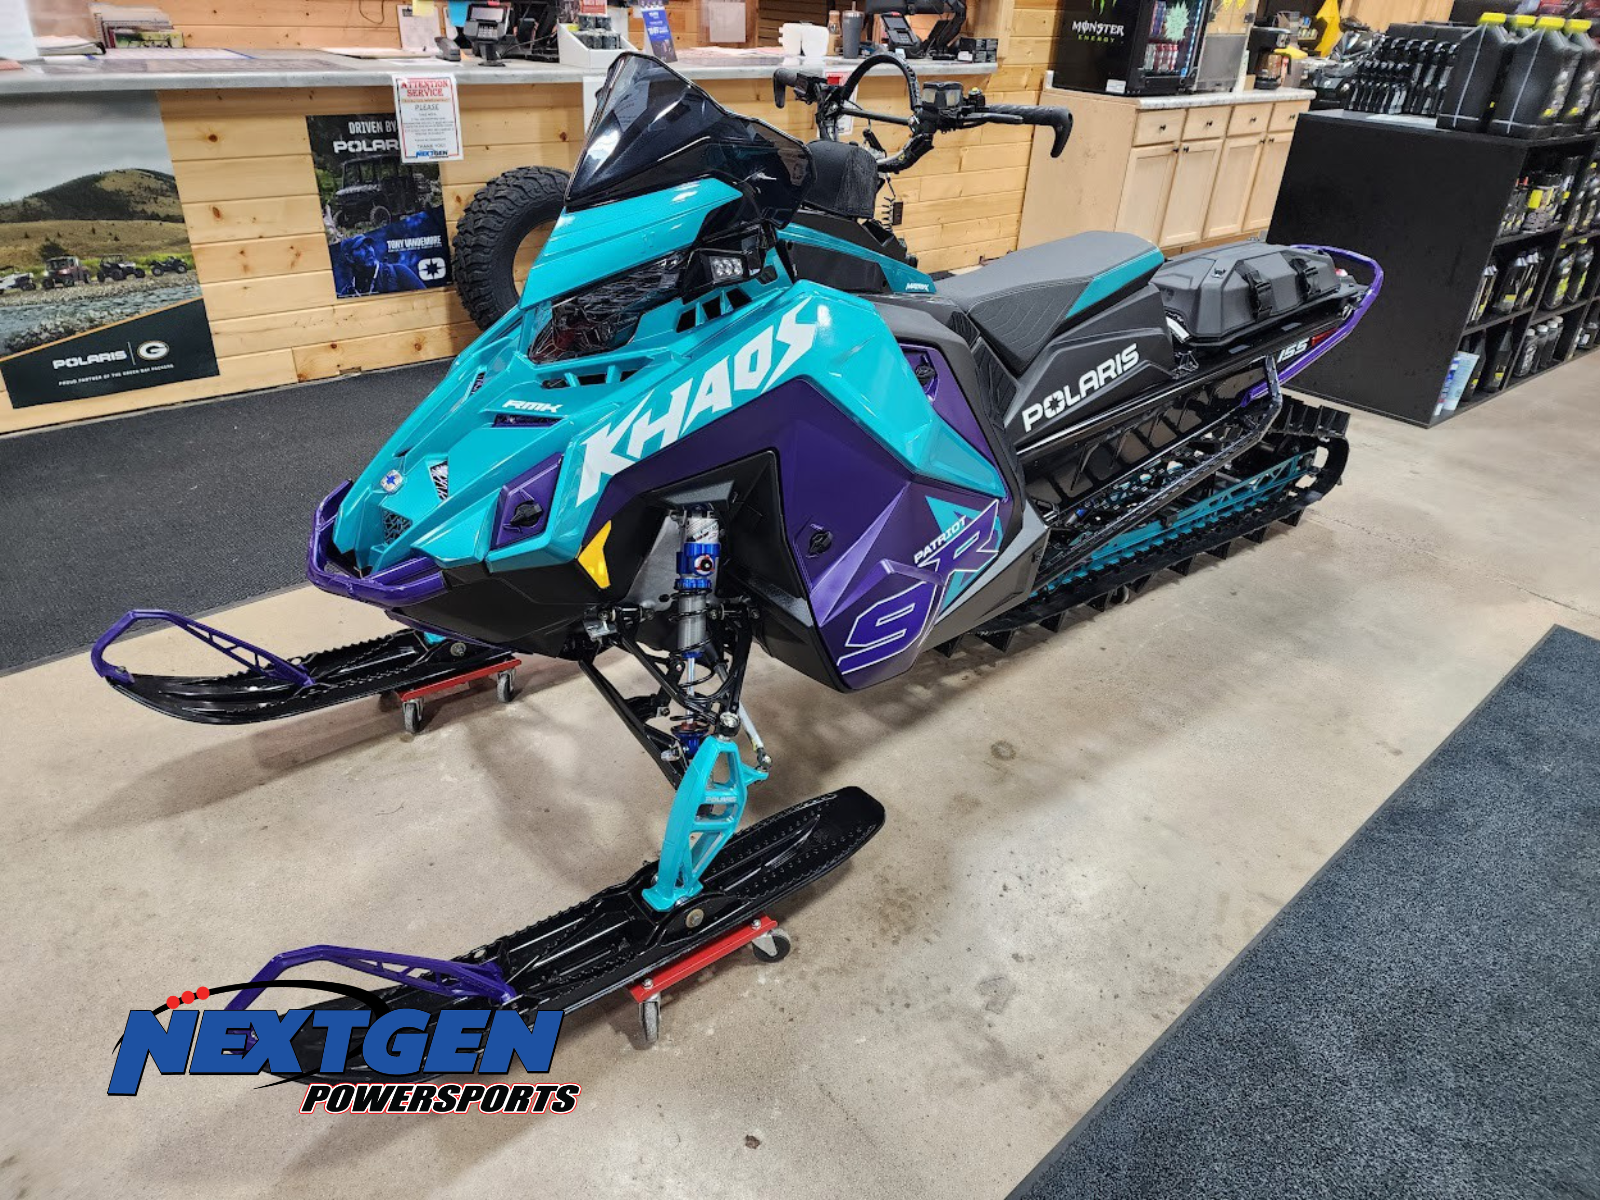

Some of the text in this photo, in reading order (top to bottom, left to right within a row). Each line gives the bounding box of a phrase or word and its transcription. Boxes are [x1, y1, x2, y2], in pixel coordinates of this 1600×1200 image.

[1072, 20, 1125, 37] MONSTER
[1078, 34, 1115, 43] ENERGY
[401, 80, 448, 88] ATTENTION
[407, 88, 443, 97] SERVICE
[414, 103, 440, 111] PLEASE
[348, 120, 397, 135] DRIVEN BY
[332, 139, 399, 154] POLAR
[415, 150, 448, 158] NEXTGEN
[1276, 337, 1310, 363] 155
[52, 351, 127, 369] POLARIS
[78, 375, 102, 383] PARTNER
[151, 363, 174, 371] PACKERS
[1021, 342, 1140, 433] POLARIS
[502, 399, 564, 413] RMK
[575, 295, 818, 508] KHAOS
[913, 515, 967, 565] PATRIOT
